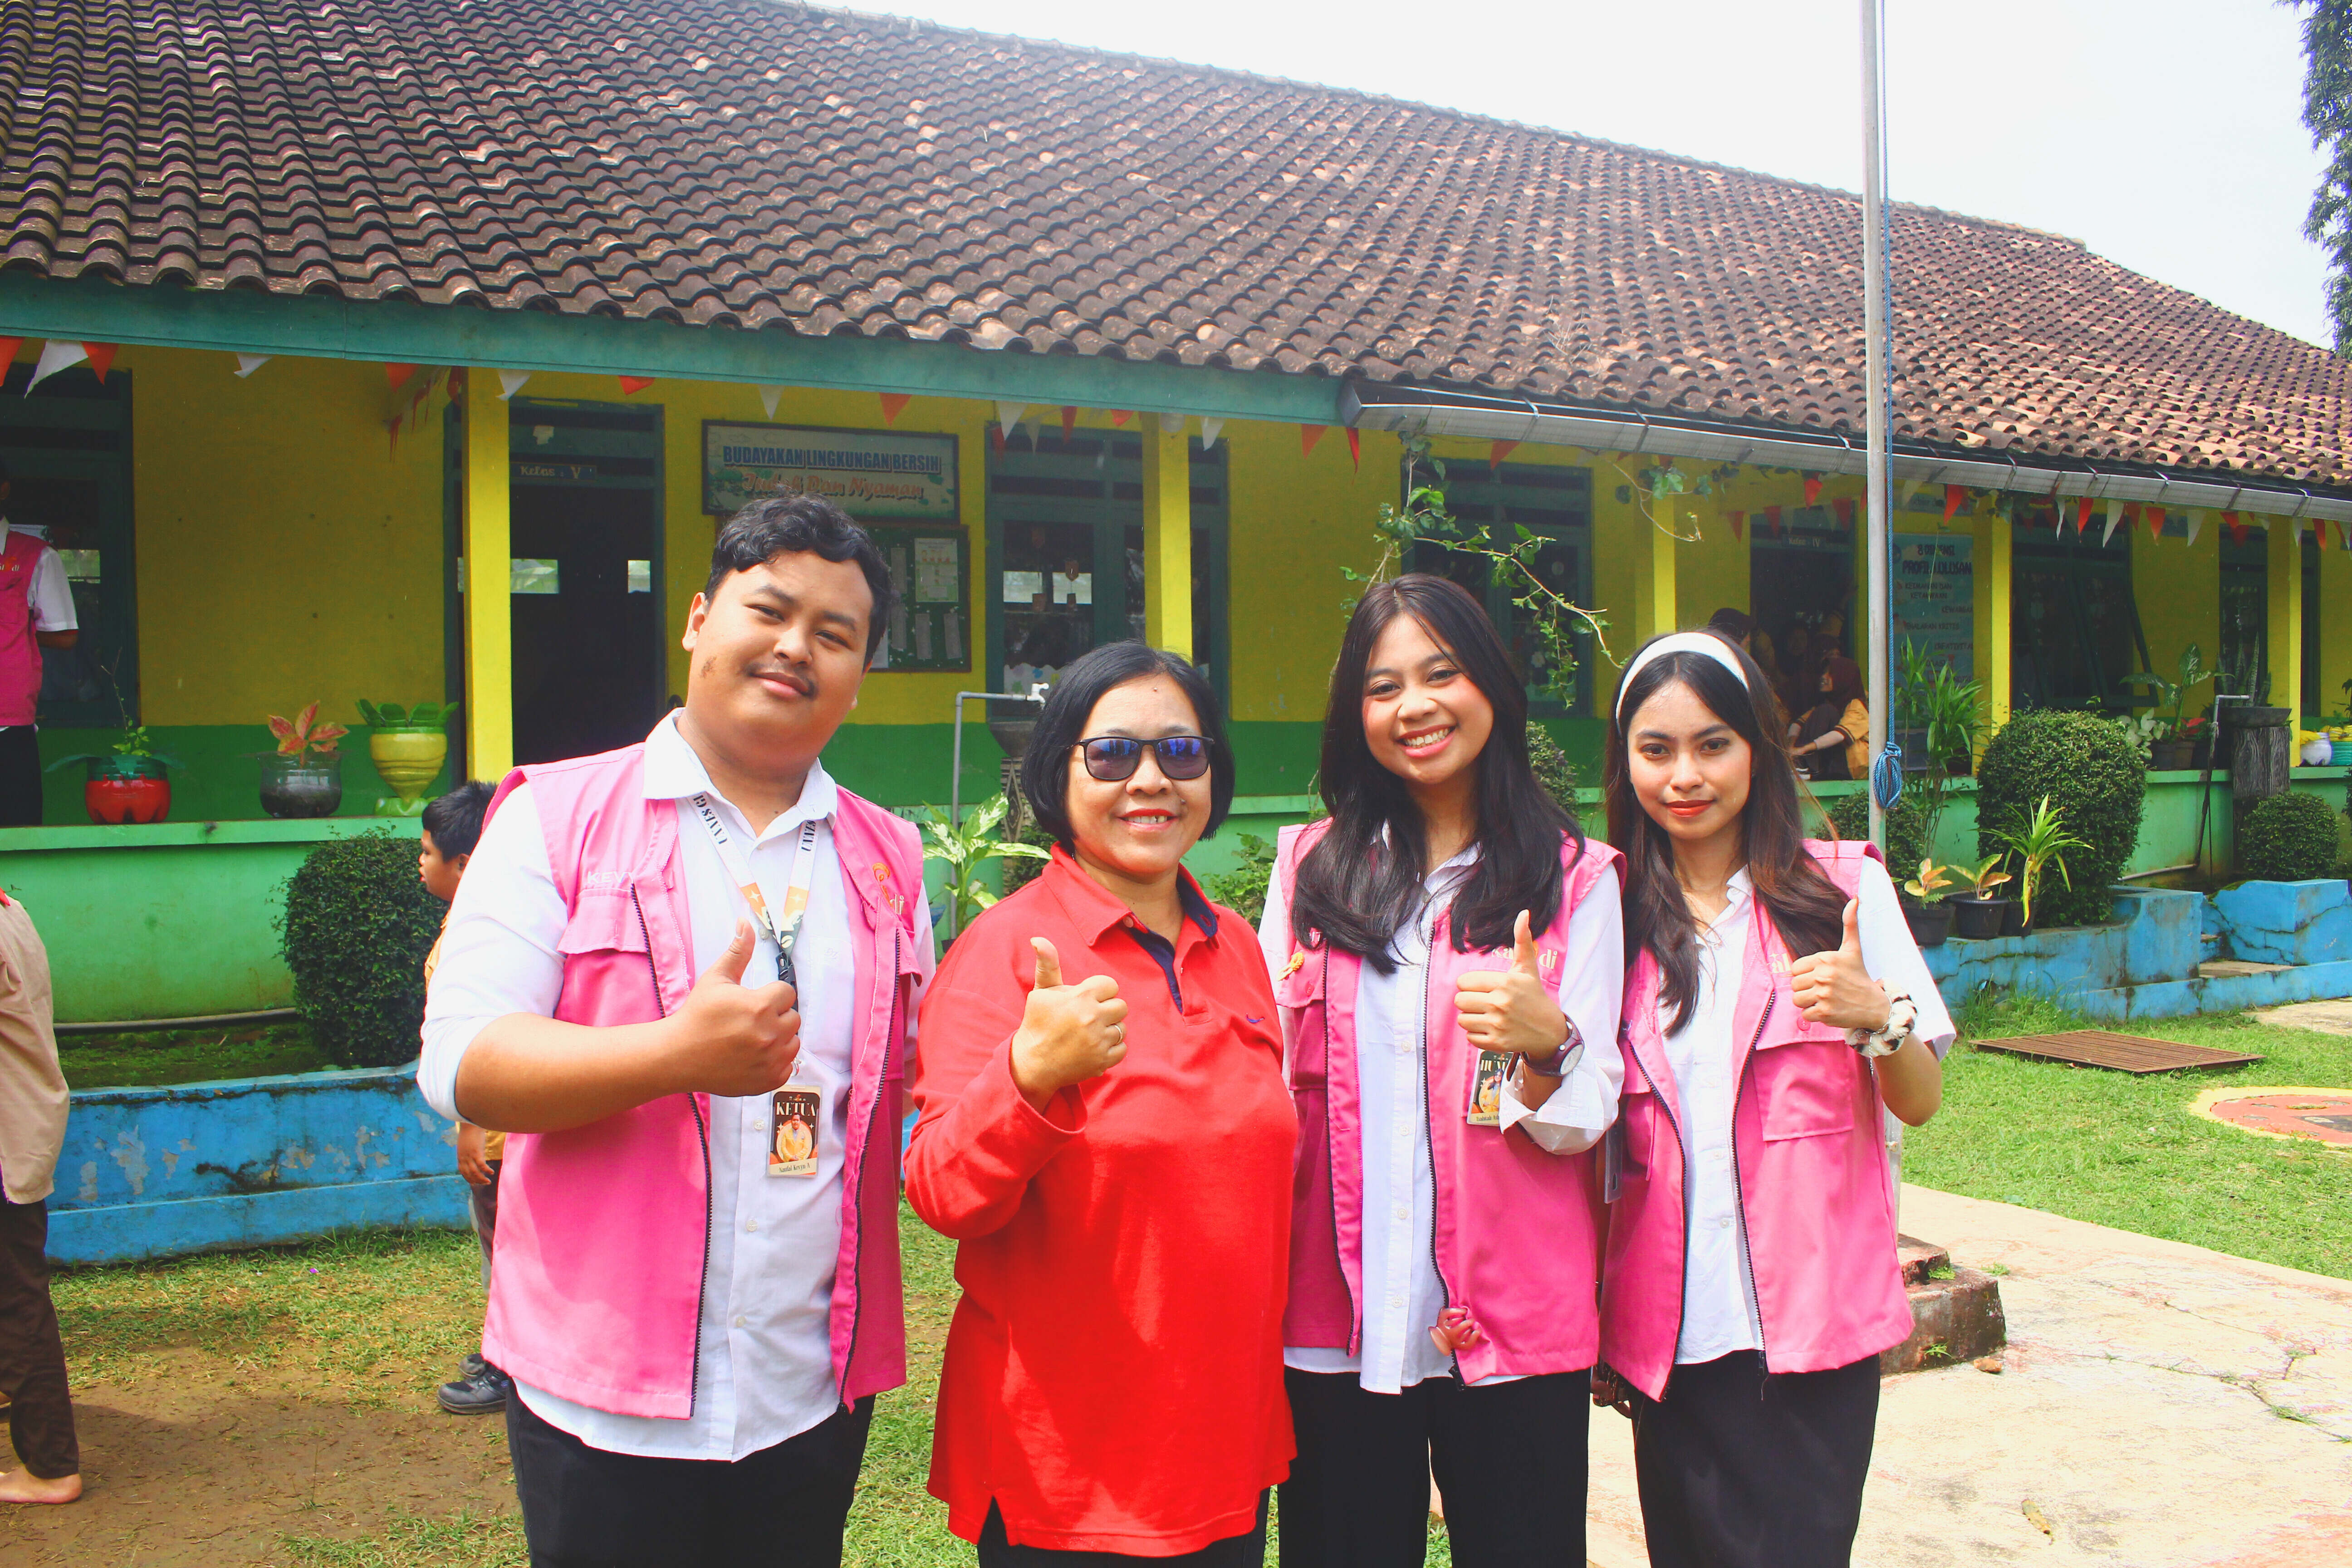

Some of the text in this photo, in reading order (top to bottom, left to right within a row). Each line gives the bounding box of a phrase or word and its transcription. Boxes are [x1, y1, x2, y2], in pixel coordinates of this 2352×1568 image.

[723, 445, 941, 473] BUDAYAKAN LINGKUNGAN BERSIH
[570, 466, 581, 479] V
[742, 473, 924, 501] Indh Dan Nyaman
[693, 794, 707, 808] GI
[701, 808, 728, 845] UNNES
[776, 1102, 817, 1117] KETUA
